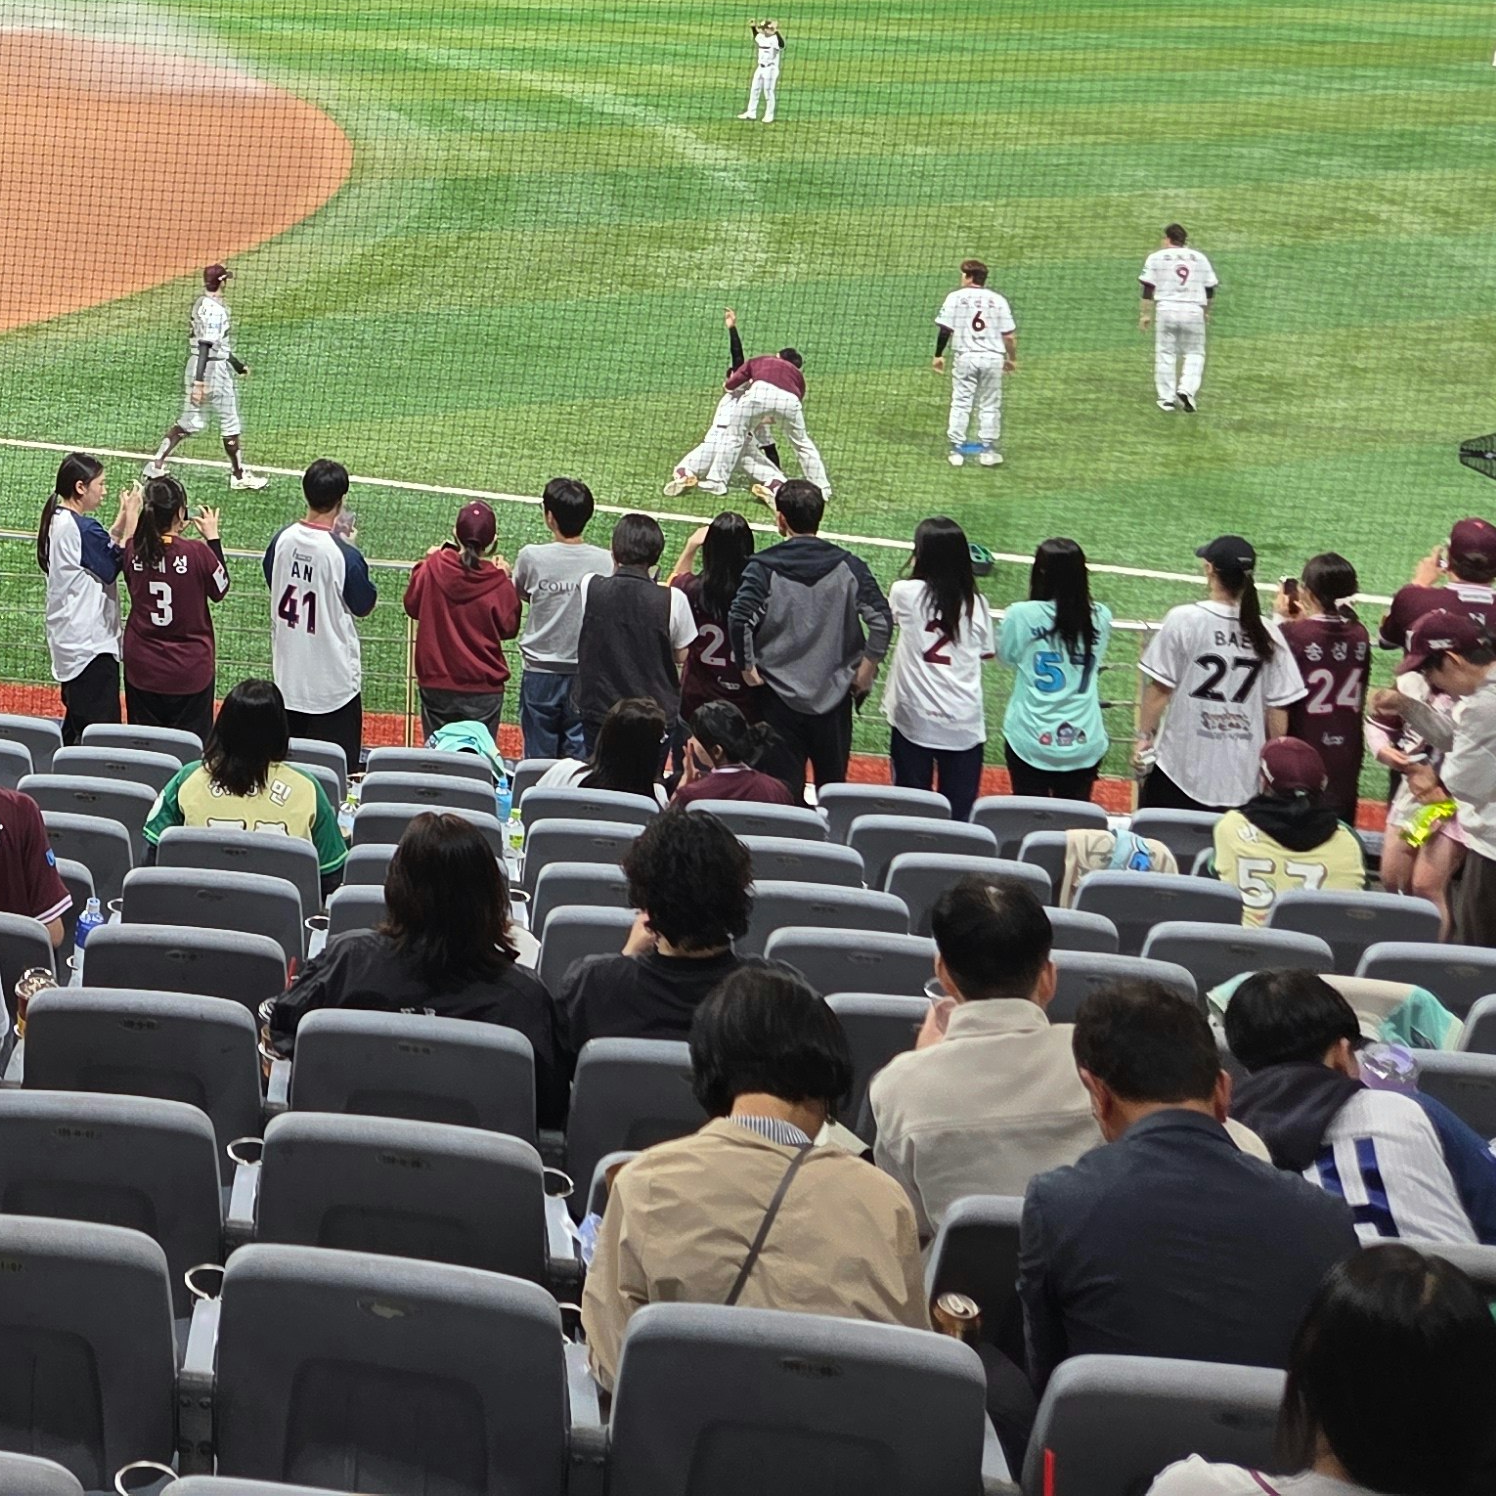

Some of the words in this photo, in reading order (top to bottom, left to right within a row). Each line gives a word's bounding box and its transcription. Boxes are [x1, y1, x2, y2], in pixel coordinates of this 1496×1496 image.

[1176, 266, 1190, 286] 9
[972, 310, 986, 332] 6
[291, 561, 313, 583] AN
[149, 581, 173, 626] 3
[278, 583, 316, 635] 41
[698, 623, 736, 667] 2
[1033, 650, 1097, 693] 57
[1189, 653, 1262, 704] 27
[1306, 667, 1363, 714] 24
